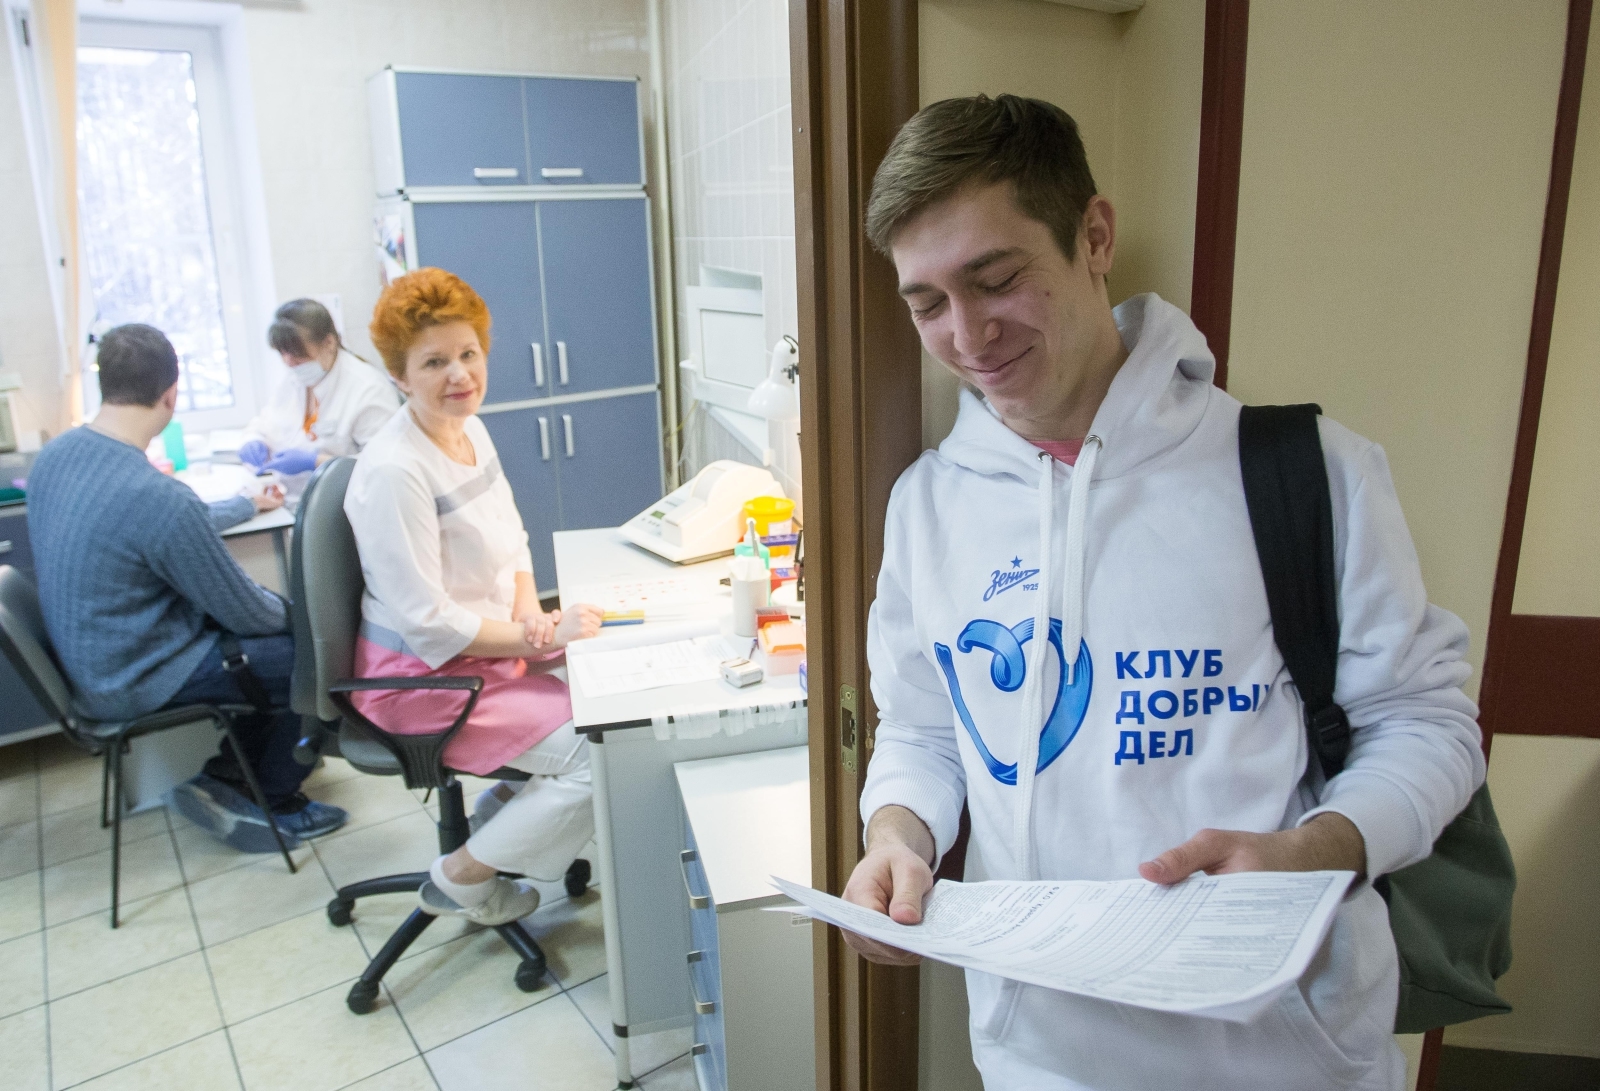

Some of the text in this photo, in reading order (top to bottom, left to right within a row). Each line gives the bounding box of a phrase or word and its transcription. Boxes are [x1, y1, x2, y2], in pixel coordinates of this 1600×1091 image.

[1022, 583, 1039, 591] 1925
[1115, 649, 1224, 680] КЛУБ
[1115, 684, 1270, 725] ДОБРЫ
[1114, 728, 1194, 766] ДЕЛ
